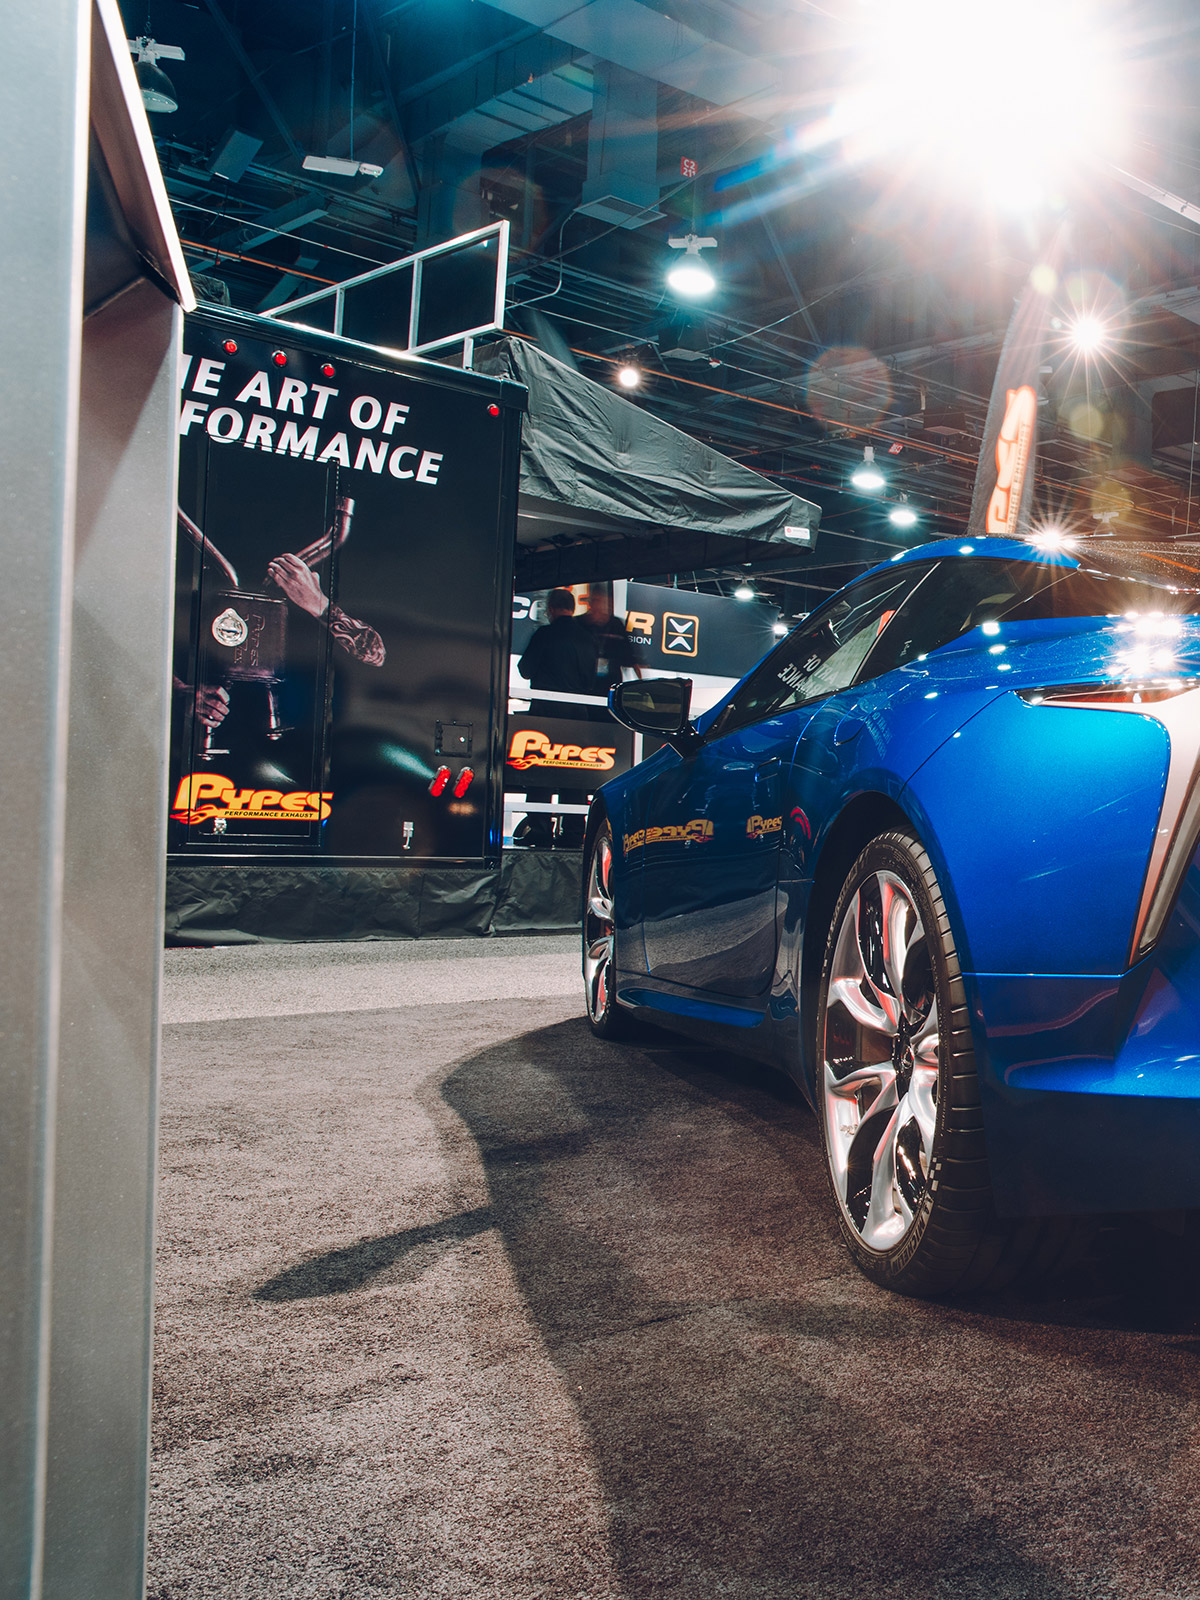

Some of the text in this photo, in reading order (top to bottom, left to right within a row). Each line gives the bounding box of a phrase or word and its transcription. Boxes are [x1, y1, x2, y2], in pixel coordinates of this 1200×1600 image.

[684, 159, 696, 170] C2
[235, 370, 339, 420] ART
[349, 395, 411, 435] OF
[179, 399, 444, 485] FORMANCE
[224, 810, 279, 818] PERFORMANCE
